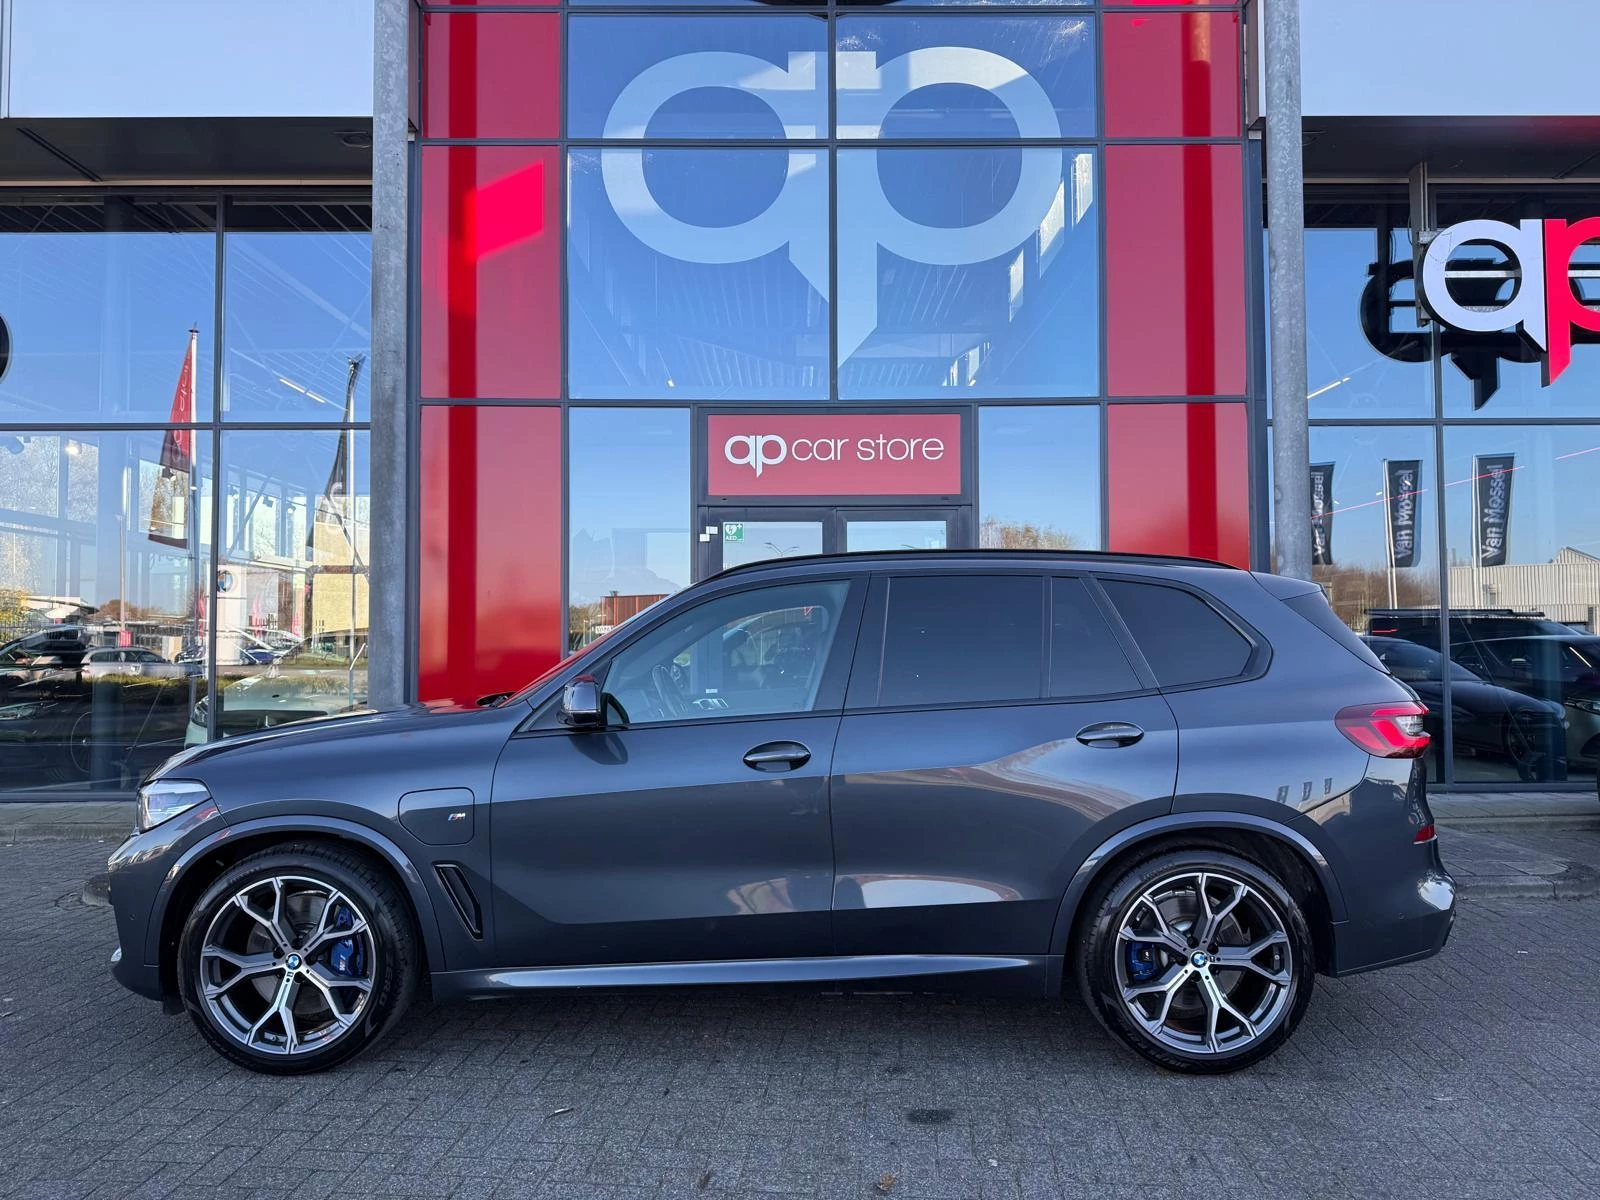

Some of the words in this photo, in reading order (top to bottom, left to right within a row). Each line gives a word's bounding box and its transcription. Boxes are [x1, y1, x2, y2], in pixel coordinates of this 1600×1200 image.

[601, 46, 1062, 368] ap
[724, 434, 788, 478] ap
[791, 438, 850, 461] car
[856, 433, 945, 461] store
[1483, 464, 1505, 523] Mossel
[1395, 529, 1413, 558] Van
[1481, 526, 1503, 558] Van
